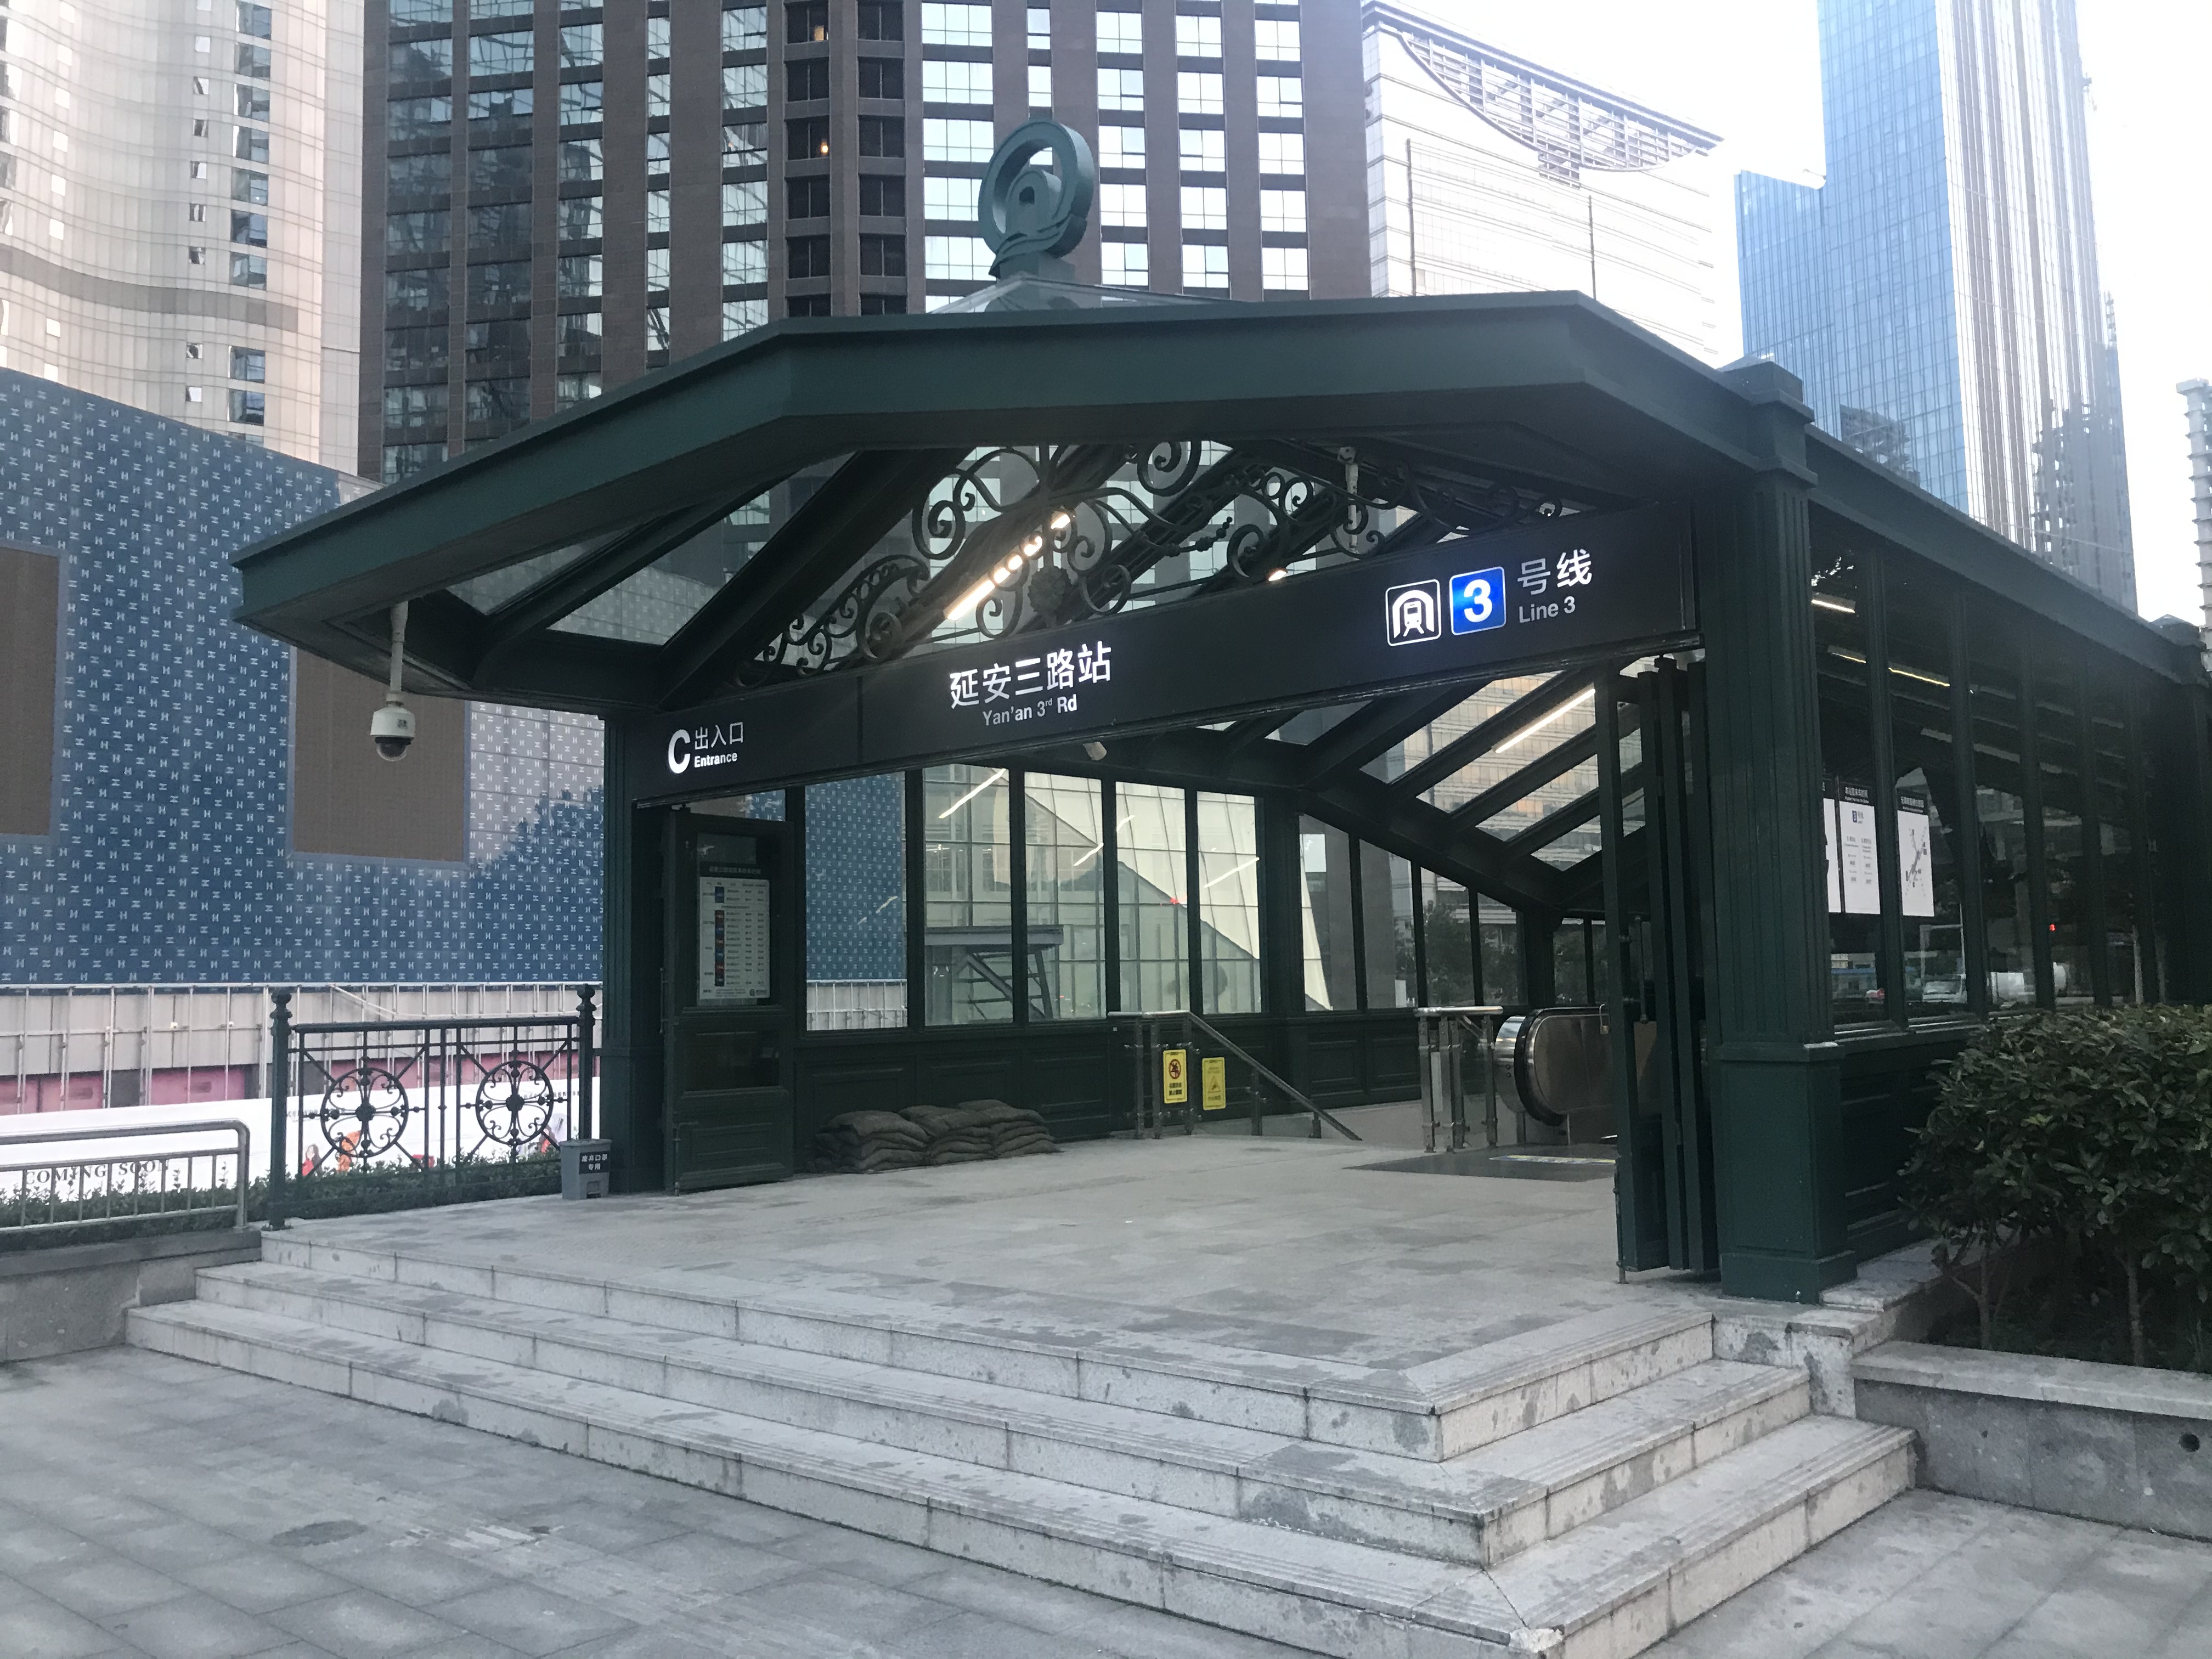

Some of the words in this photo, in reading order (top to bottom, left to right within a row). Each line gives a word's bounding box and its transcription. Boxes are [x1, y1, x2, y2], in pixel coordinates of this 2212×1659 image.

[1463, 579, 1493, 623] 3
[1517, 548, 1593, 595] 号线
[1518, 602, 1559, 624] Line
[1563, 596, 1576, 614] 3
[949, 640, 1112, 710] 延安三路站
[982, 706, 1032, 726] Yan'an
[1036, 697, 1053, 718] 3rd
[1057, 693, 1077, 714] Rd
[668, 729, 691, 774] C
[694, 721, 744, 751] 出入口
[693, 752, 738, 768] Entrance
[26, 1165, 106, 1184] COMING
